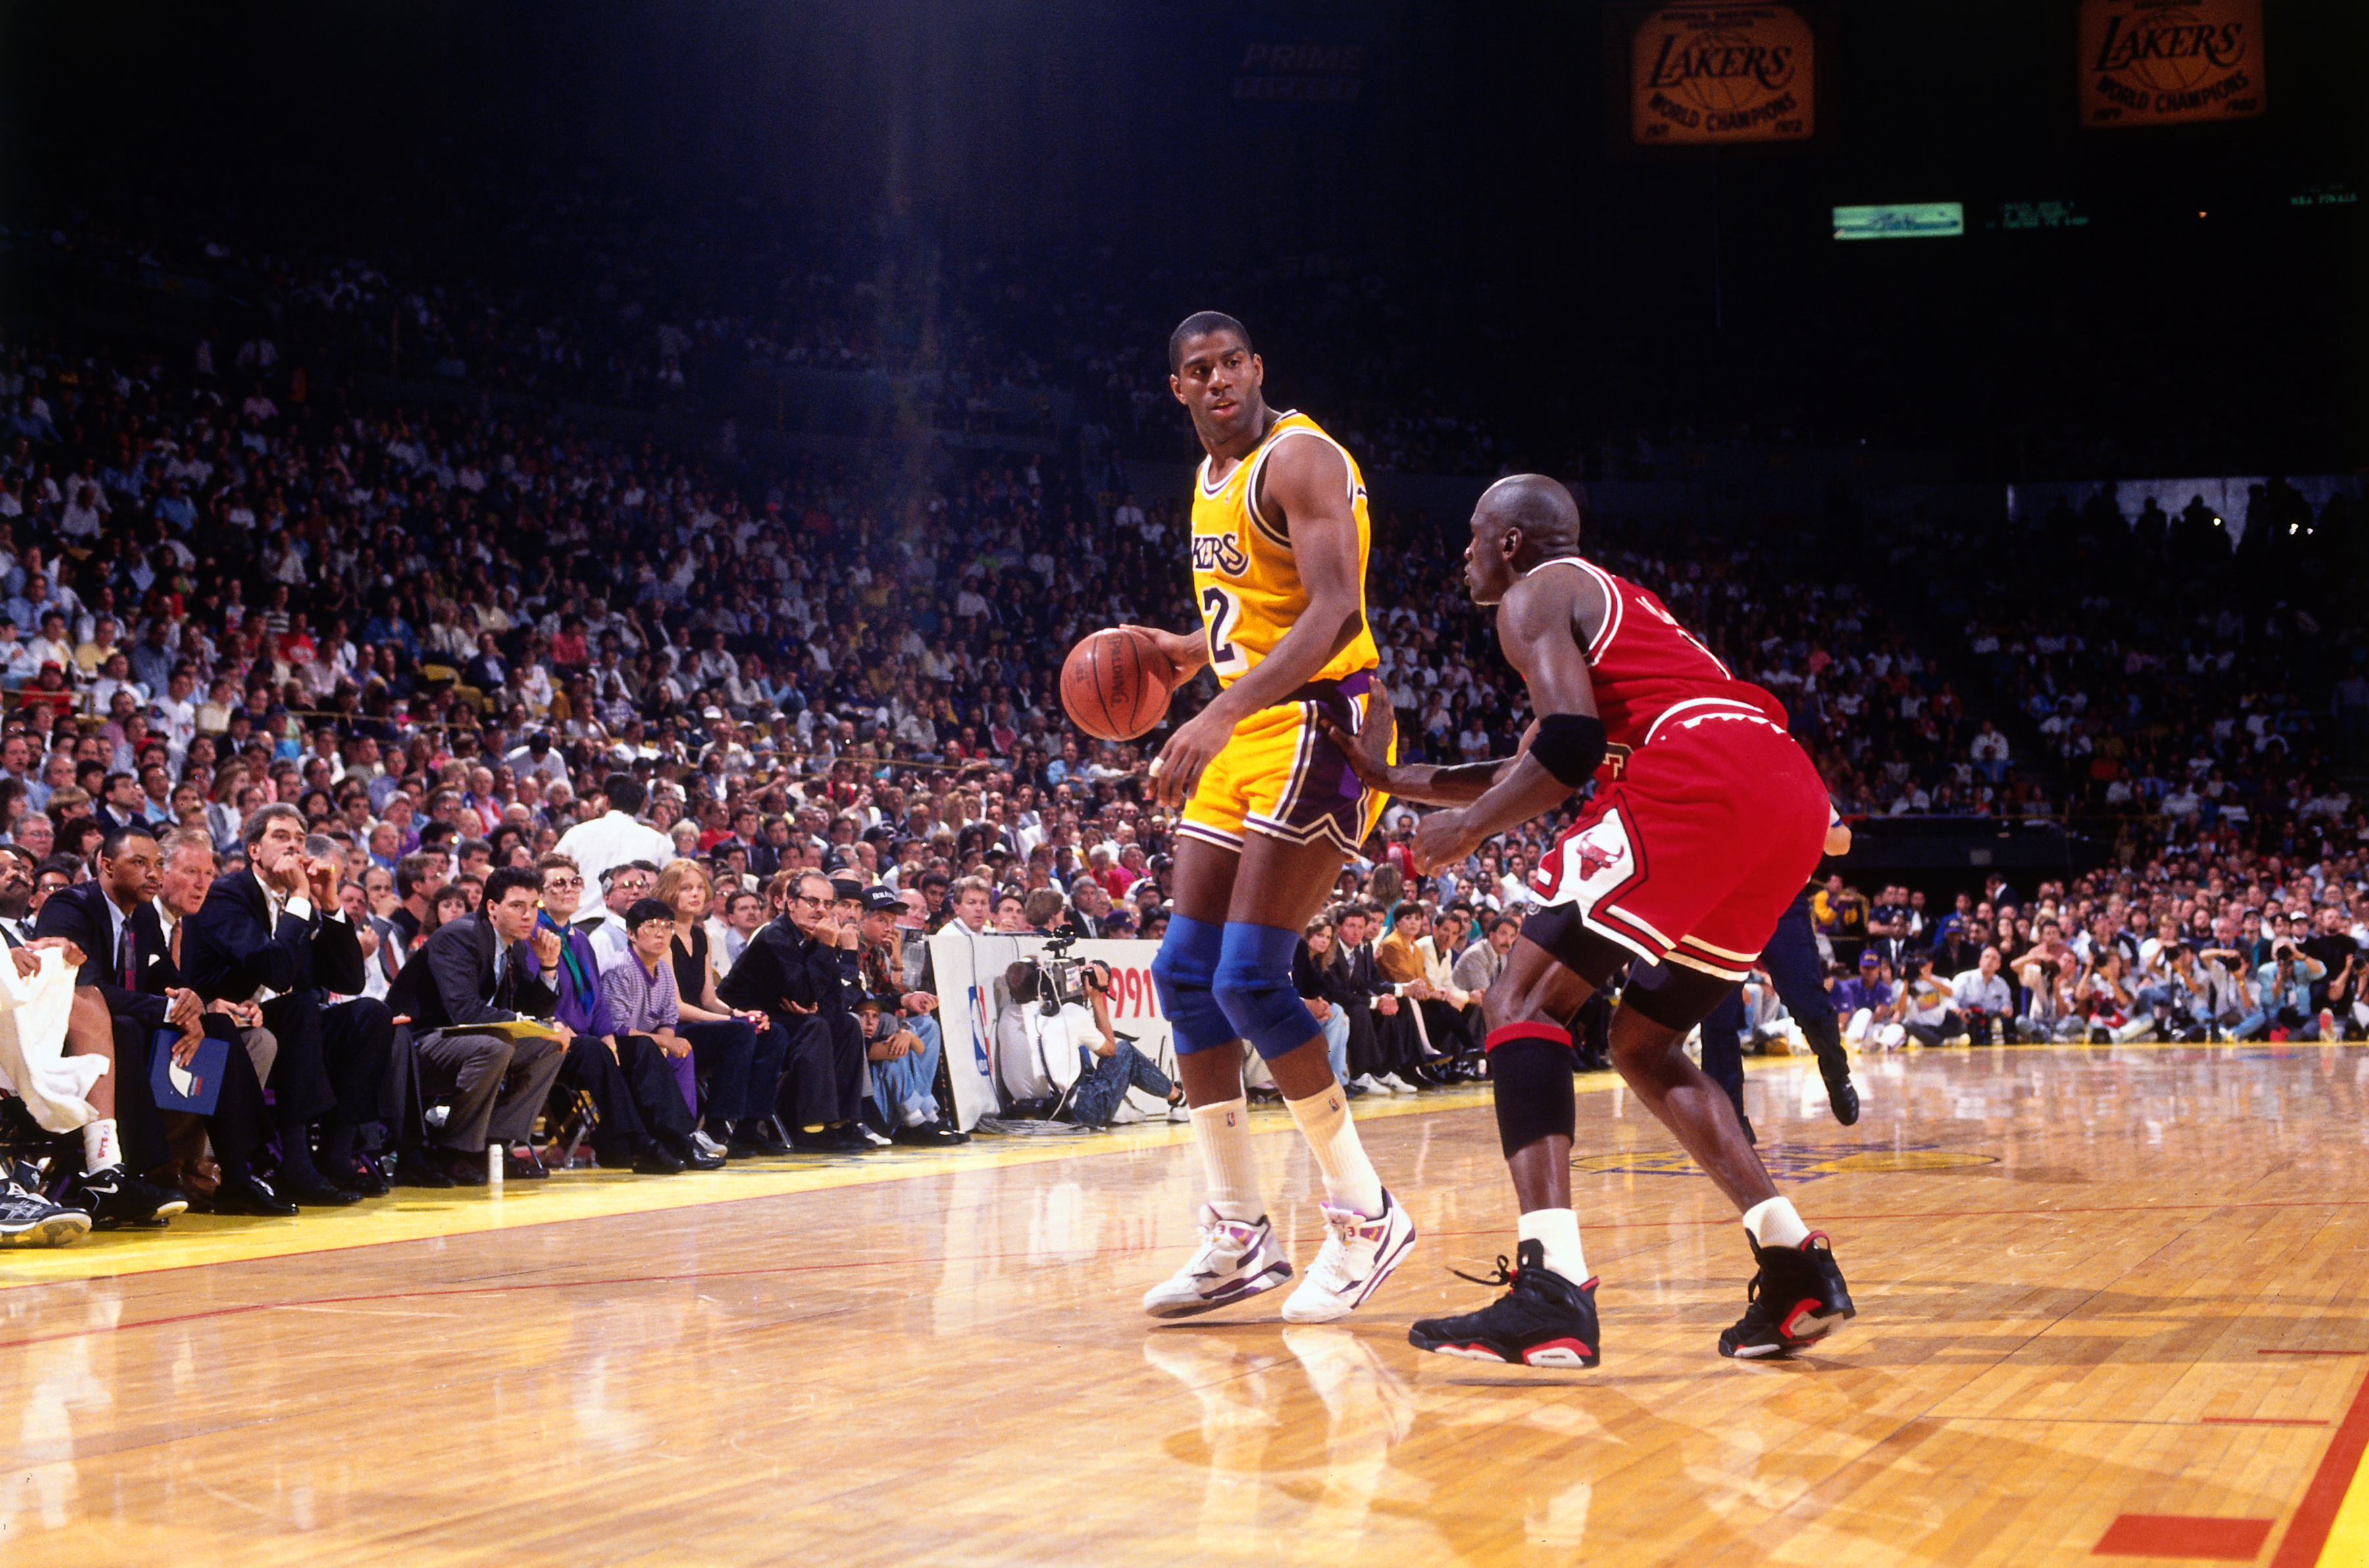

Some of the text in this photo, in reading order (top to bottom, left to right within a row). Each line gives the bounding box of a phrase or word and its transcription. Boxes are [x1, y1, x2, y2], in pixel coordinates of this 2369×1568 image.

[1240, 36, 1371, 72] PRIME
[1641, 34, 1795, 89] LAKERS
[2092, 15, 2247, 68] LAKERS
[1649, 91, 1797, 132] WORLD CHAMPIONS
[2096, 70, 2250, 113] WORLD CHAMPIONS
[1202, 586, 1244, 671] 2
[1106, 634, 1129, 707] SPALDING
[1102, 967, 1155, 1018] 991
